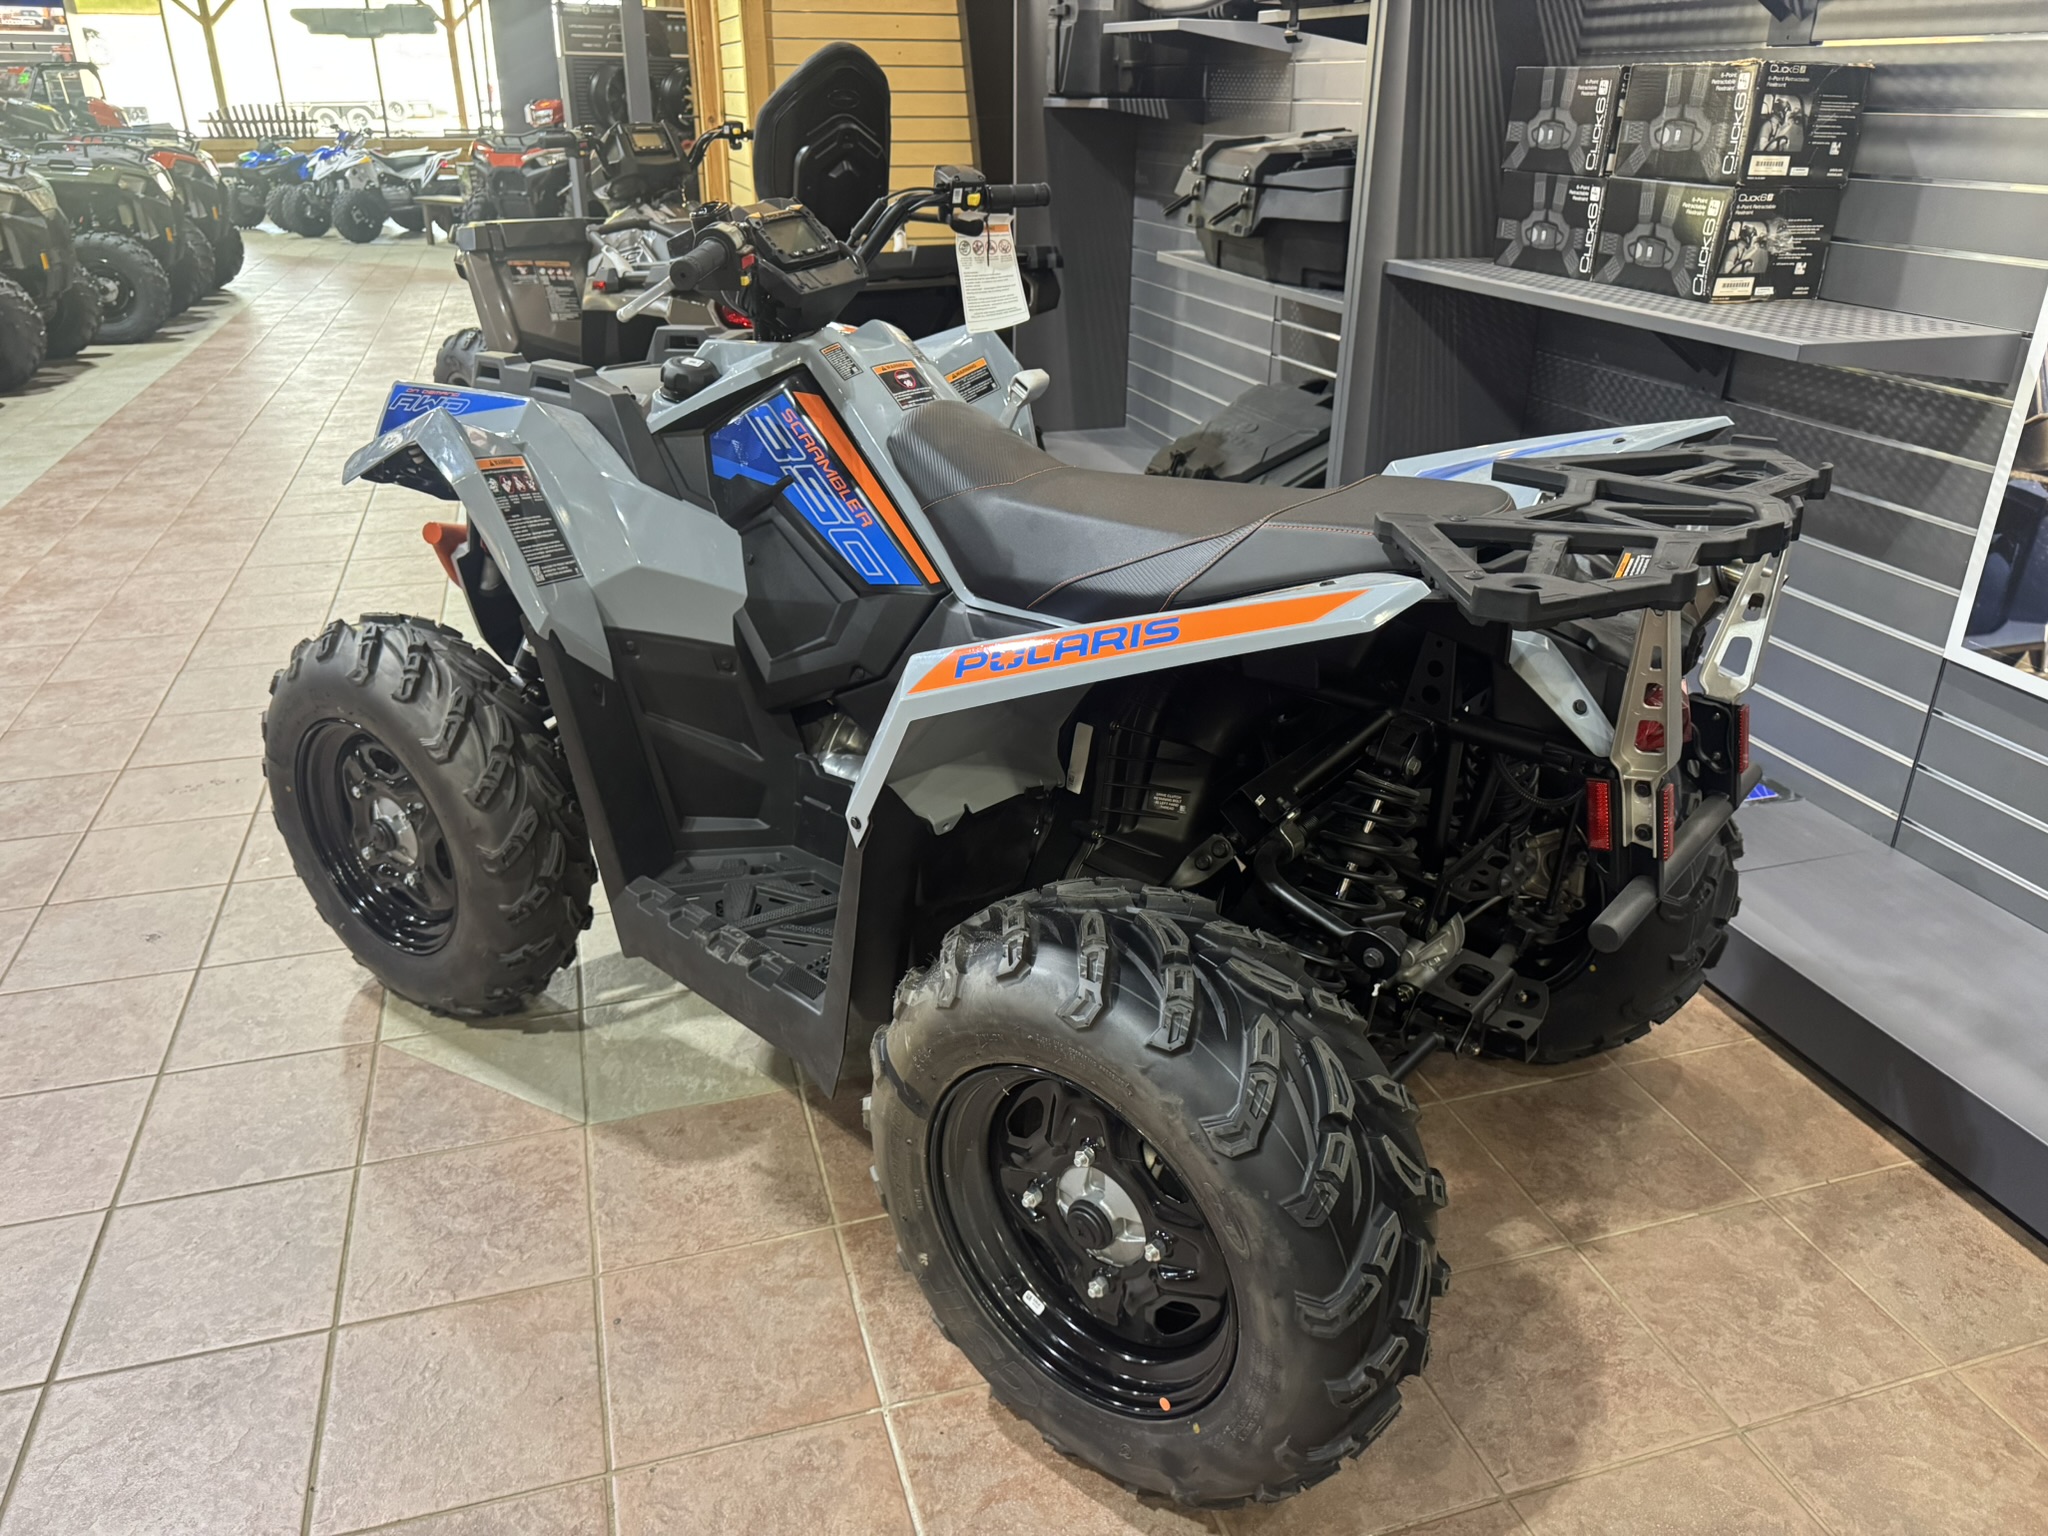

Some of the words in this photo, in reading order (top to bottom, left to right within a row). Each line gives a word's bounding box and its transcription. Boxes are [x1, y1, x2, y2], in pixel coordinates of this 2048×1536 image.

[1585, 97, 1607, 170] CLICK6
[1722, 92, 1747, 174] CLICK6
[1579, 203, 1598, 273] CLICK6
[1692, 218, 1716, 295] CLICK6
[388, 393, 471, 415] AWD
[781, 408, 874, 528] SCRAMBLER
[954, 617, 1181, 679] POLARIS
